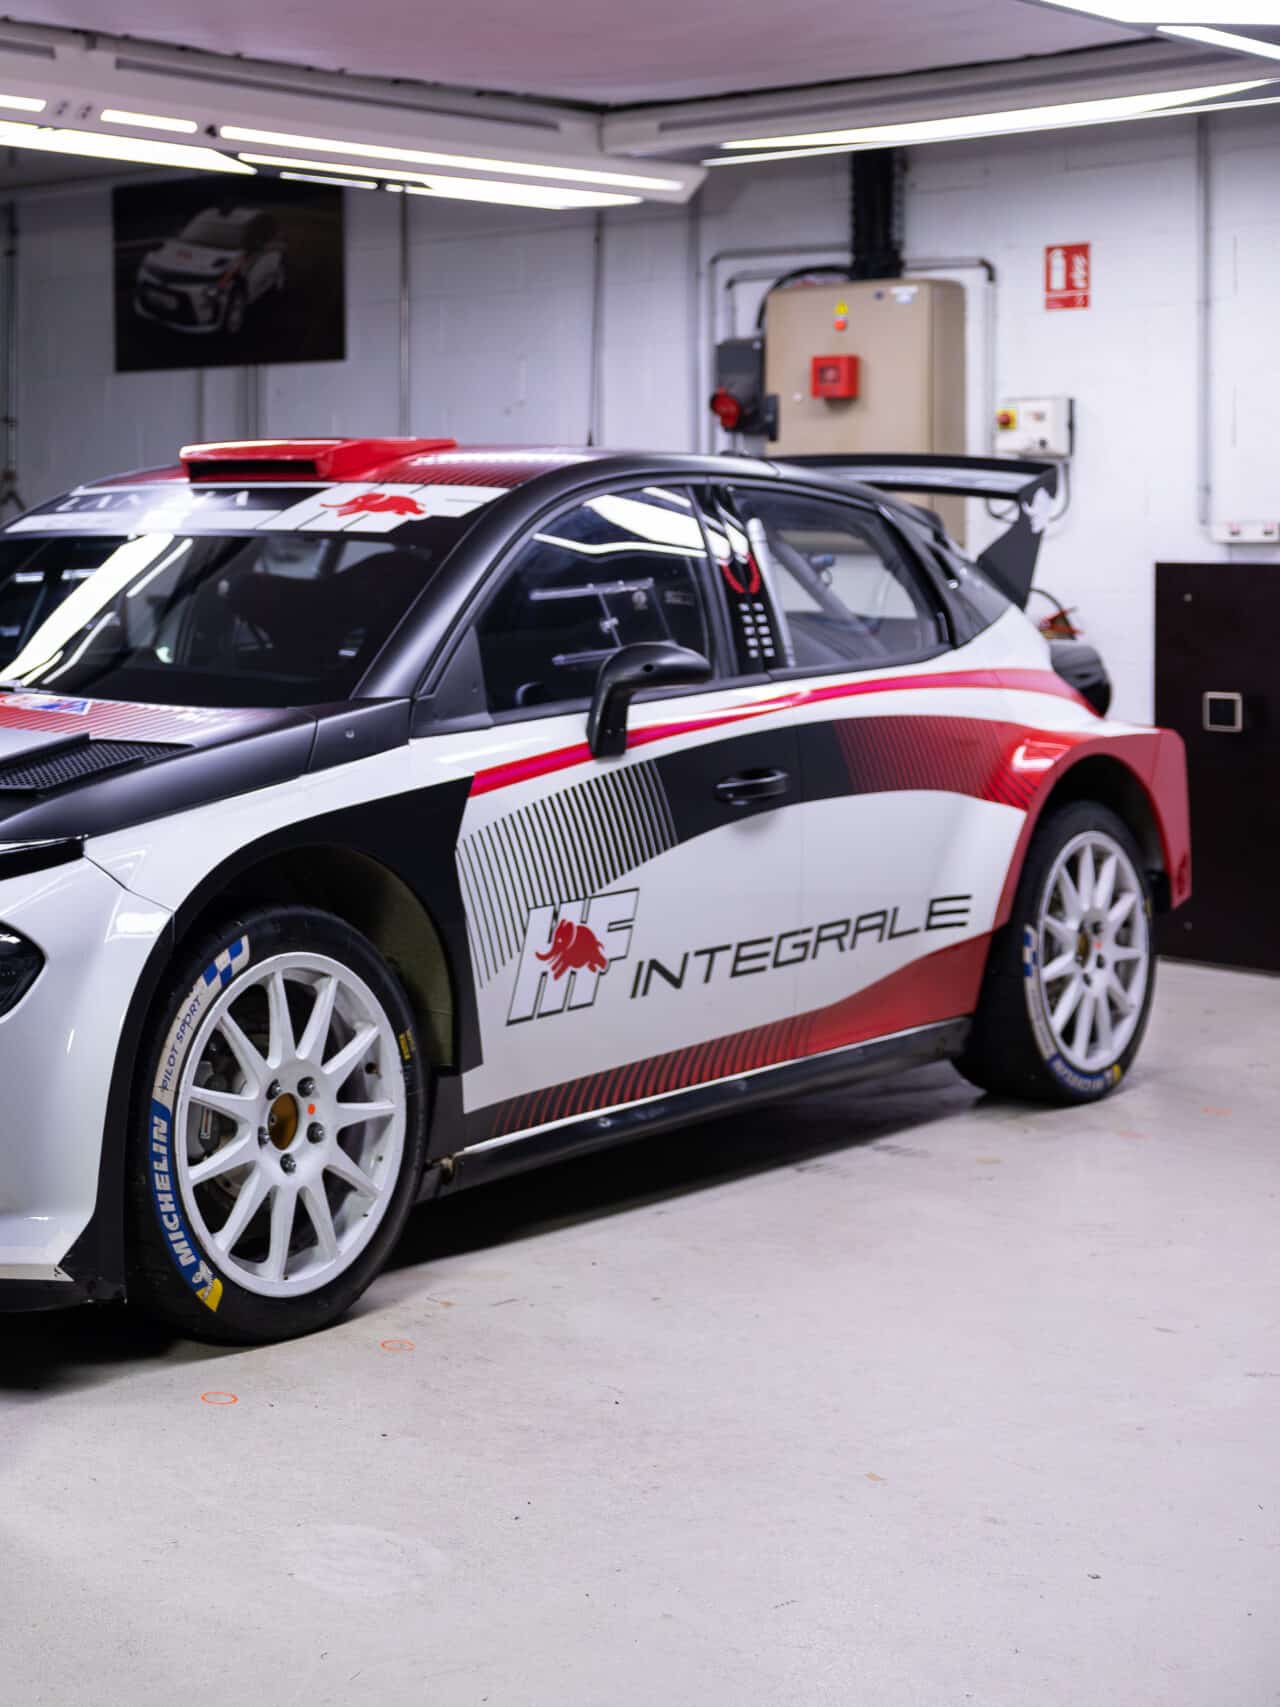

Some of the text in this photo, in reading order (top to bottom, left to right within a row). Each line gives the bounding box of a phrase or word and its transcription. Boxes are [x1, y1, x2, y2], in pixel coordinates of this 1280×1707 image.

[507, 888, 973, 1025] HF INTEGRALE
[161, 994, 201, 1093] PILOT SPORT
[152, 1115, 196, 1267] MICHELIN
